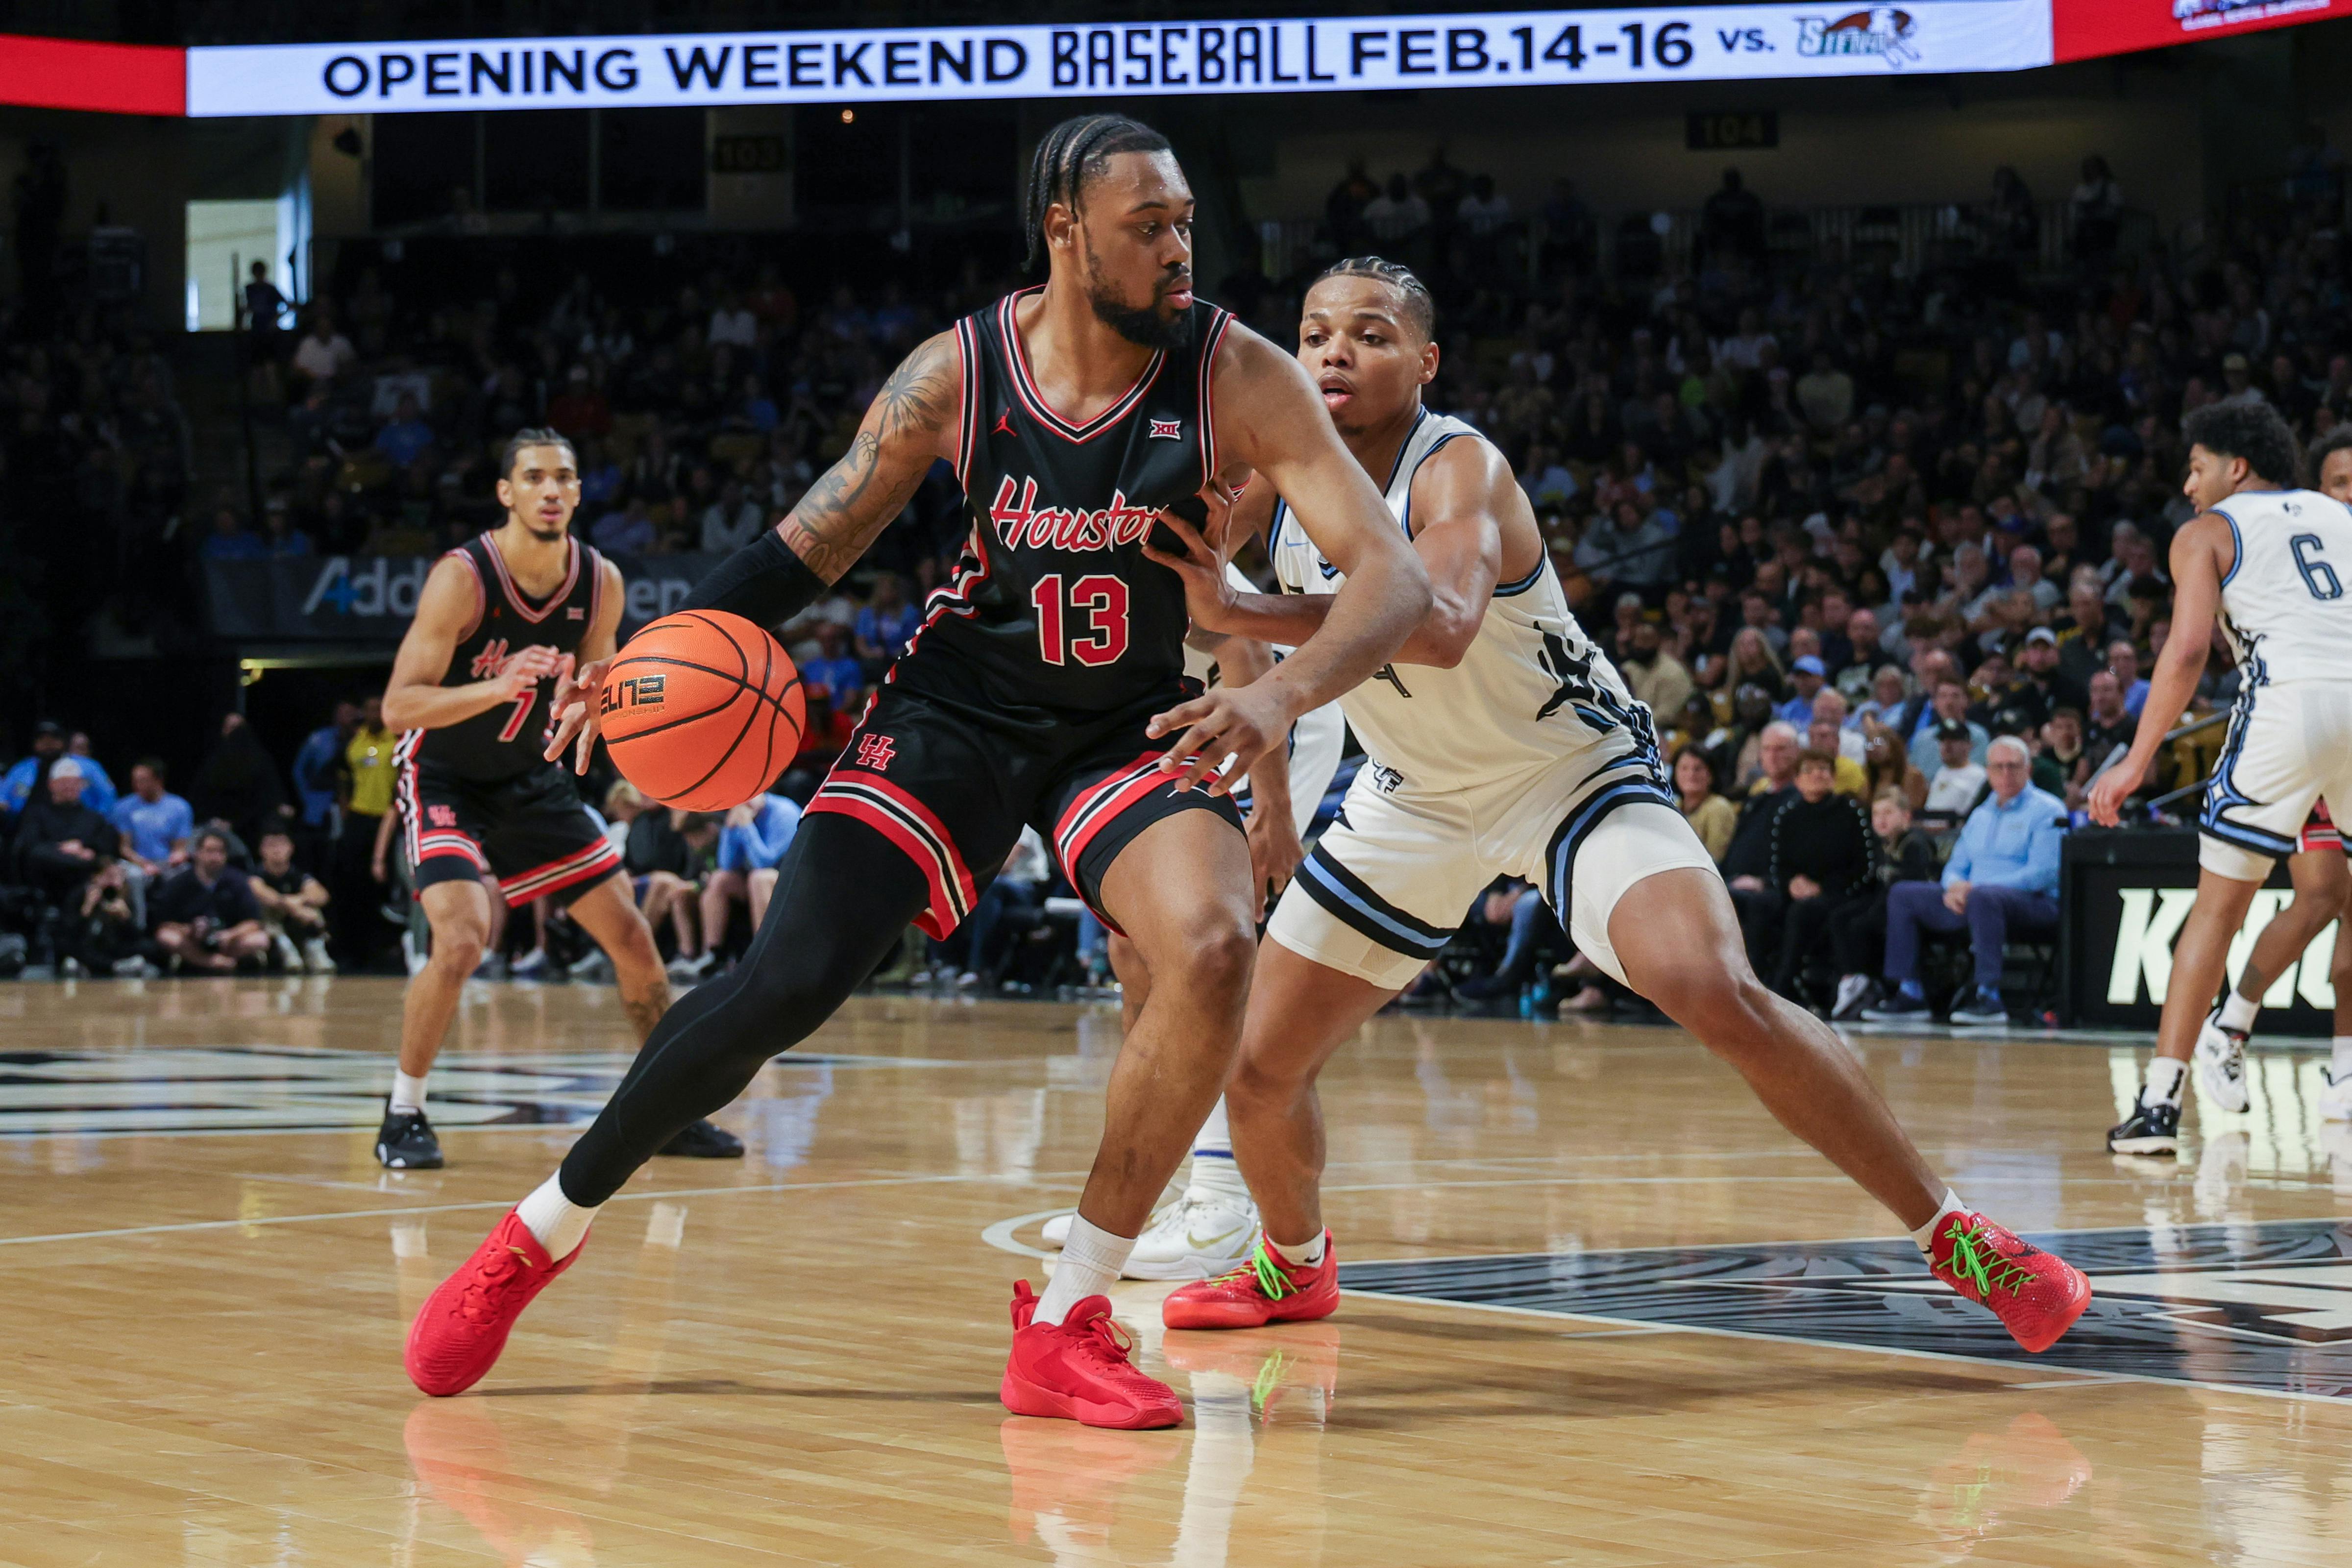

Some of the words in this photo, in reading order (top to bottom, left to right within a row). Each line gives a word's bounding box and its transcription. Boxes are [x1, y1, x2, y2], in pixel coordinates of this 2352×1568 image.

[323, 48, 638, 98] OPENING
[663, 39, 1028, 91] WEEKEND
[1051, 25, 1336, 88] BASEBALL
[1718, 30, 1775, 52] vs.
[2290, 534, 2343, 600] 6
[1031, 574, 1129, 667] 13
[497, 687, 538, 743] 7
[856, 733, 896, 771] UH
